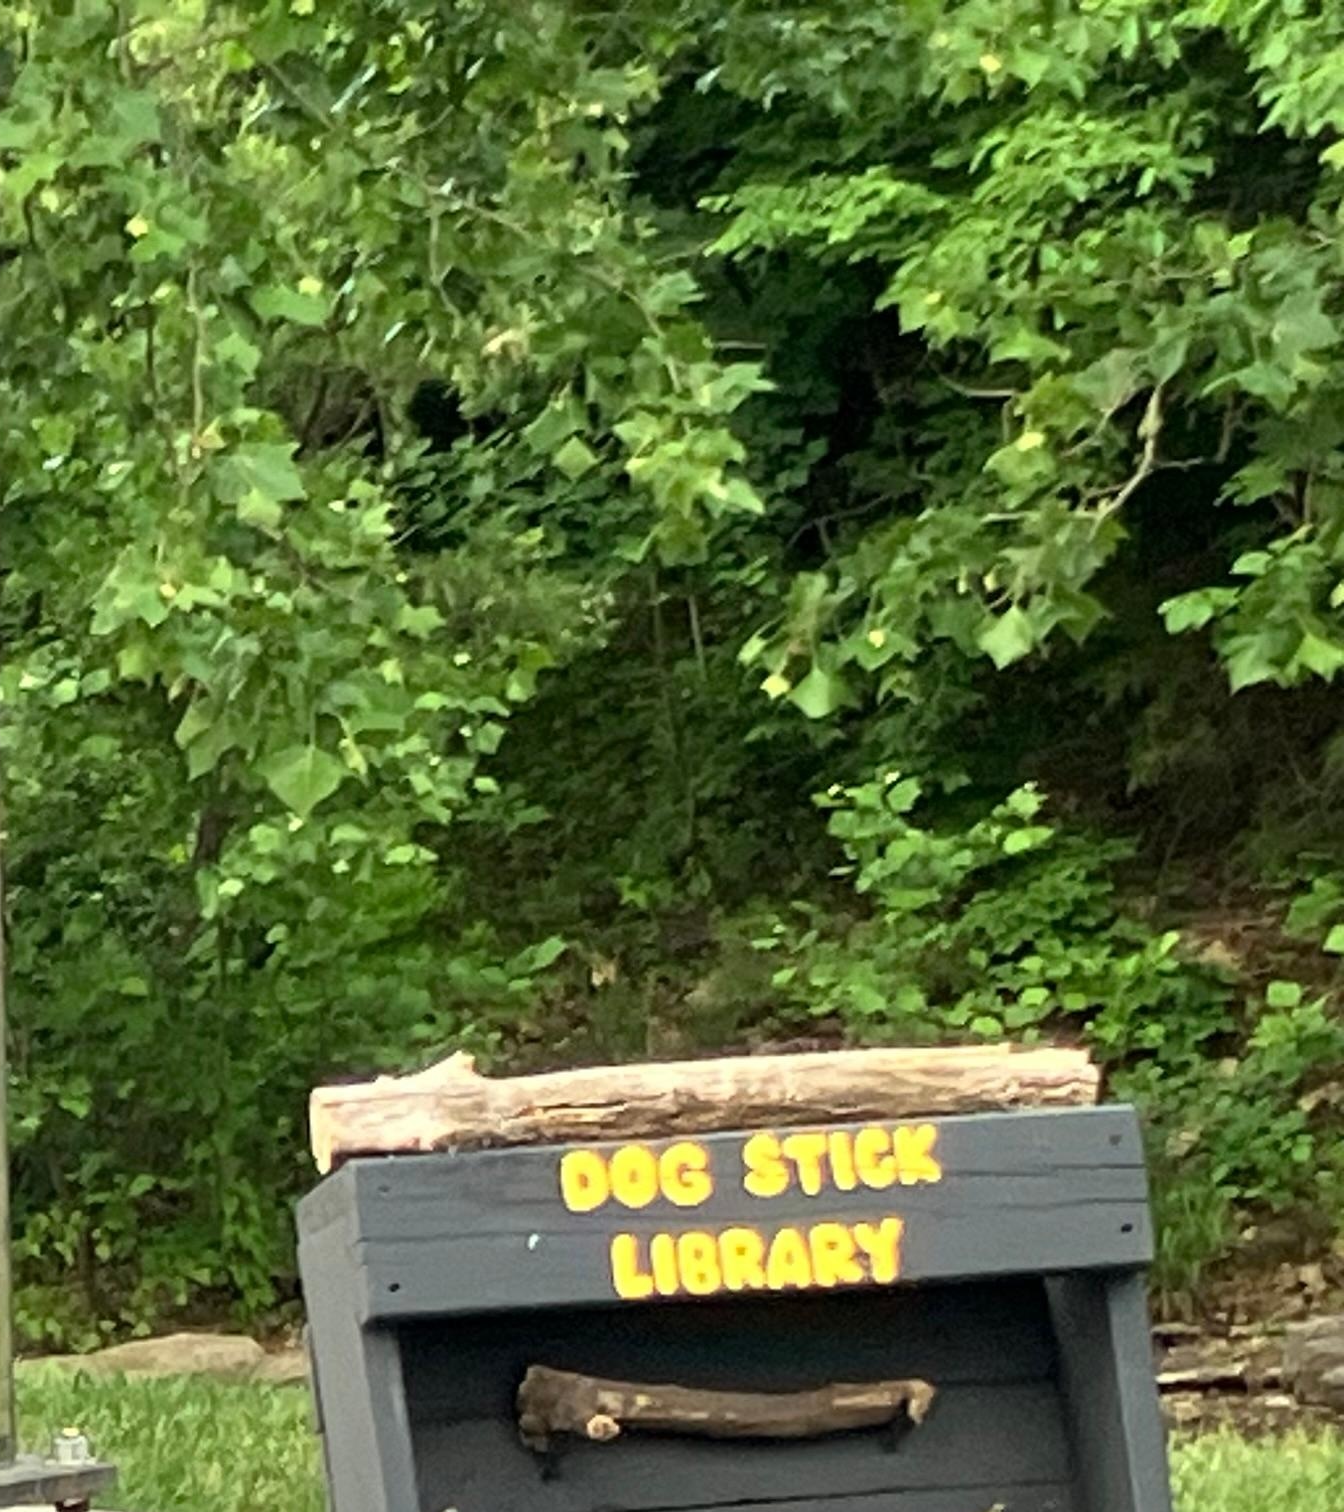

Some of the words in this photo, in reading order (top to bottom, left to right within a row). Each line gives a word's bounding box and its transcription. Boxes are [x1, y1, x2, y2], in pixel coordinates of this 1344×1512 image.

[560, 1142, 712, 1213] DOG
[742, 1122, 942, 1197] STICK
[609, 1216, 903, 1299] LIBRARY
